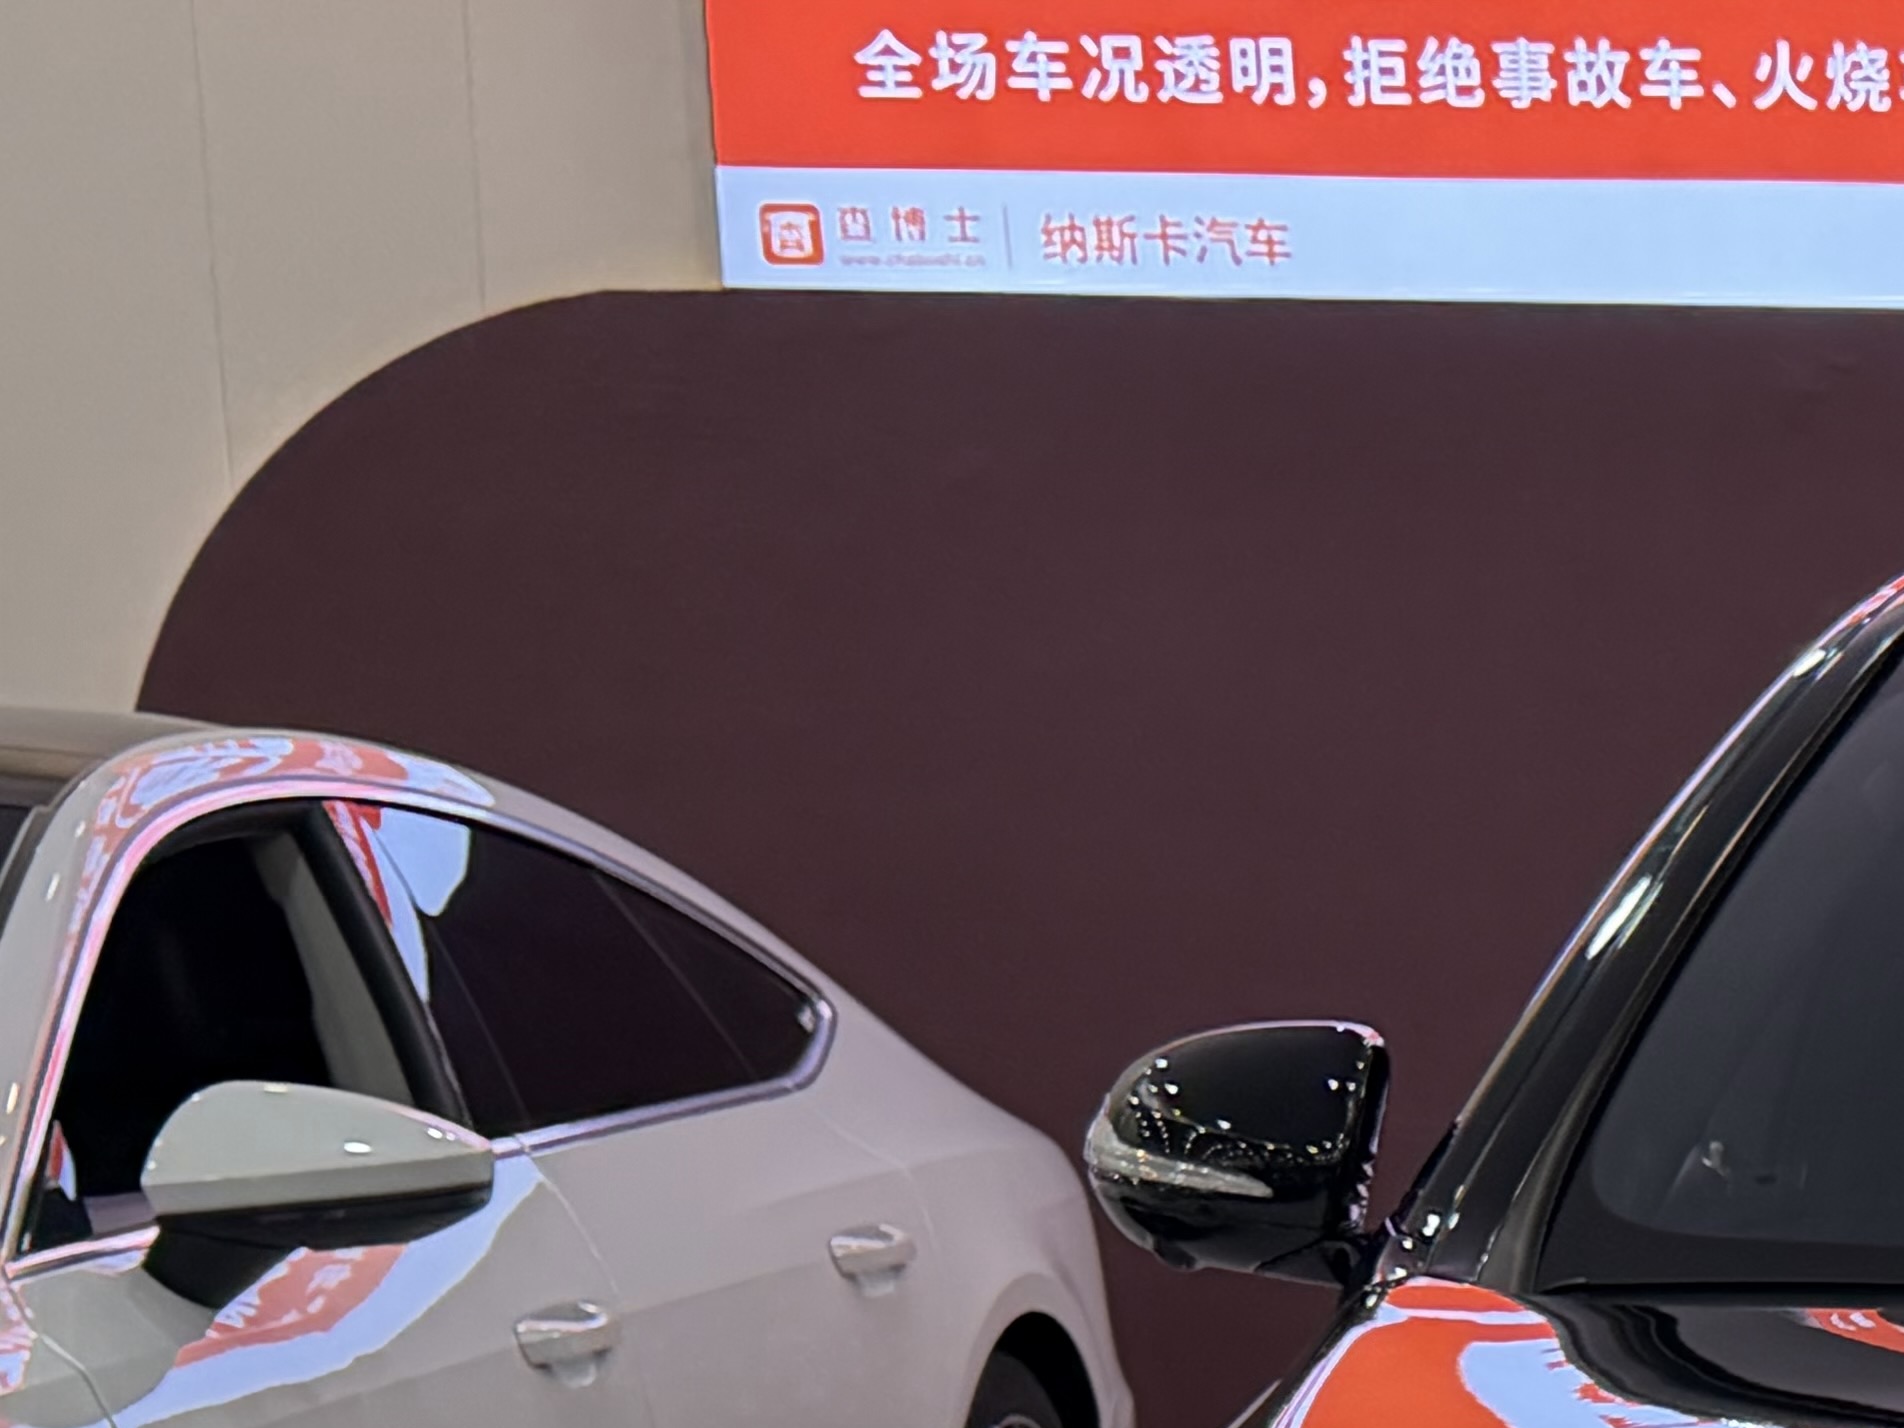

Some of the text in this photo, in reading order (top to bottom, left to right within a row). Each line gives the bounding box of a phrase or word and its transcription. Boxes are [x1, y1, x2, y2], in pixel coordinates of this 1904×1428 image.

[1041, 213, 1292, 266] 纳斯卡汽车
